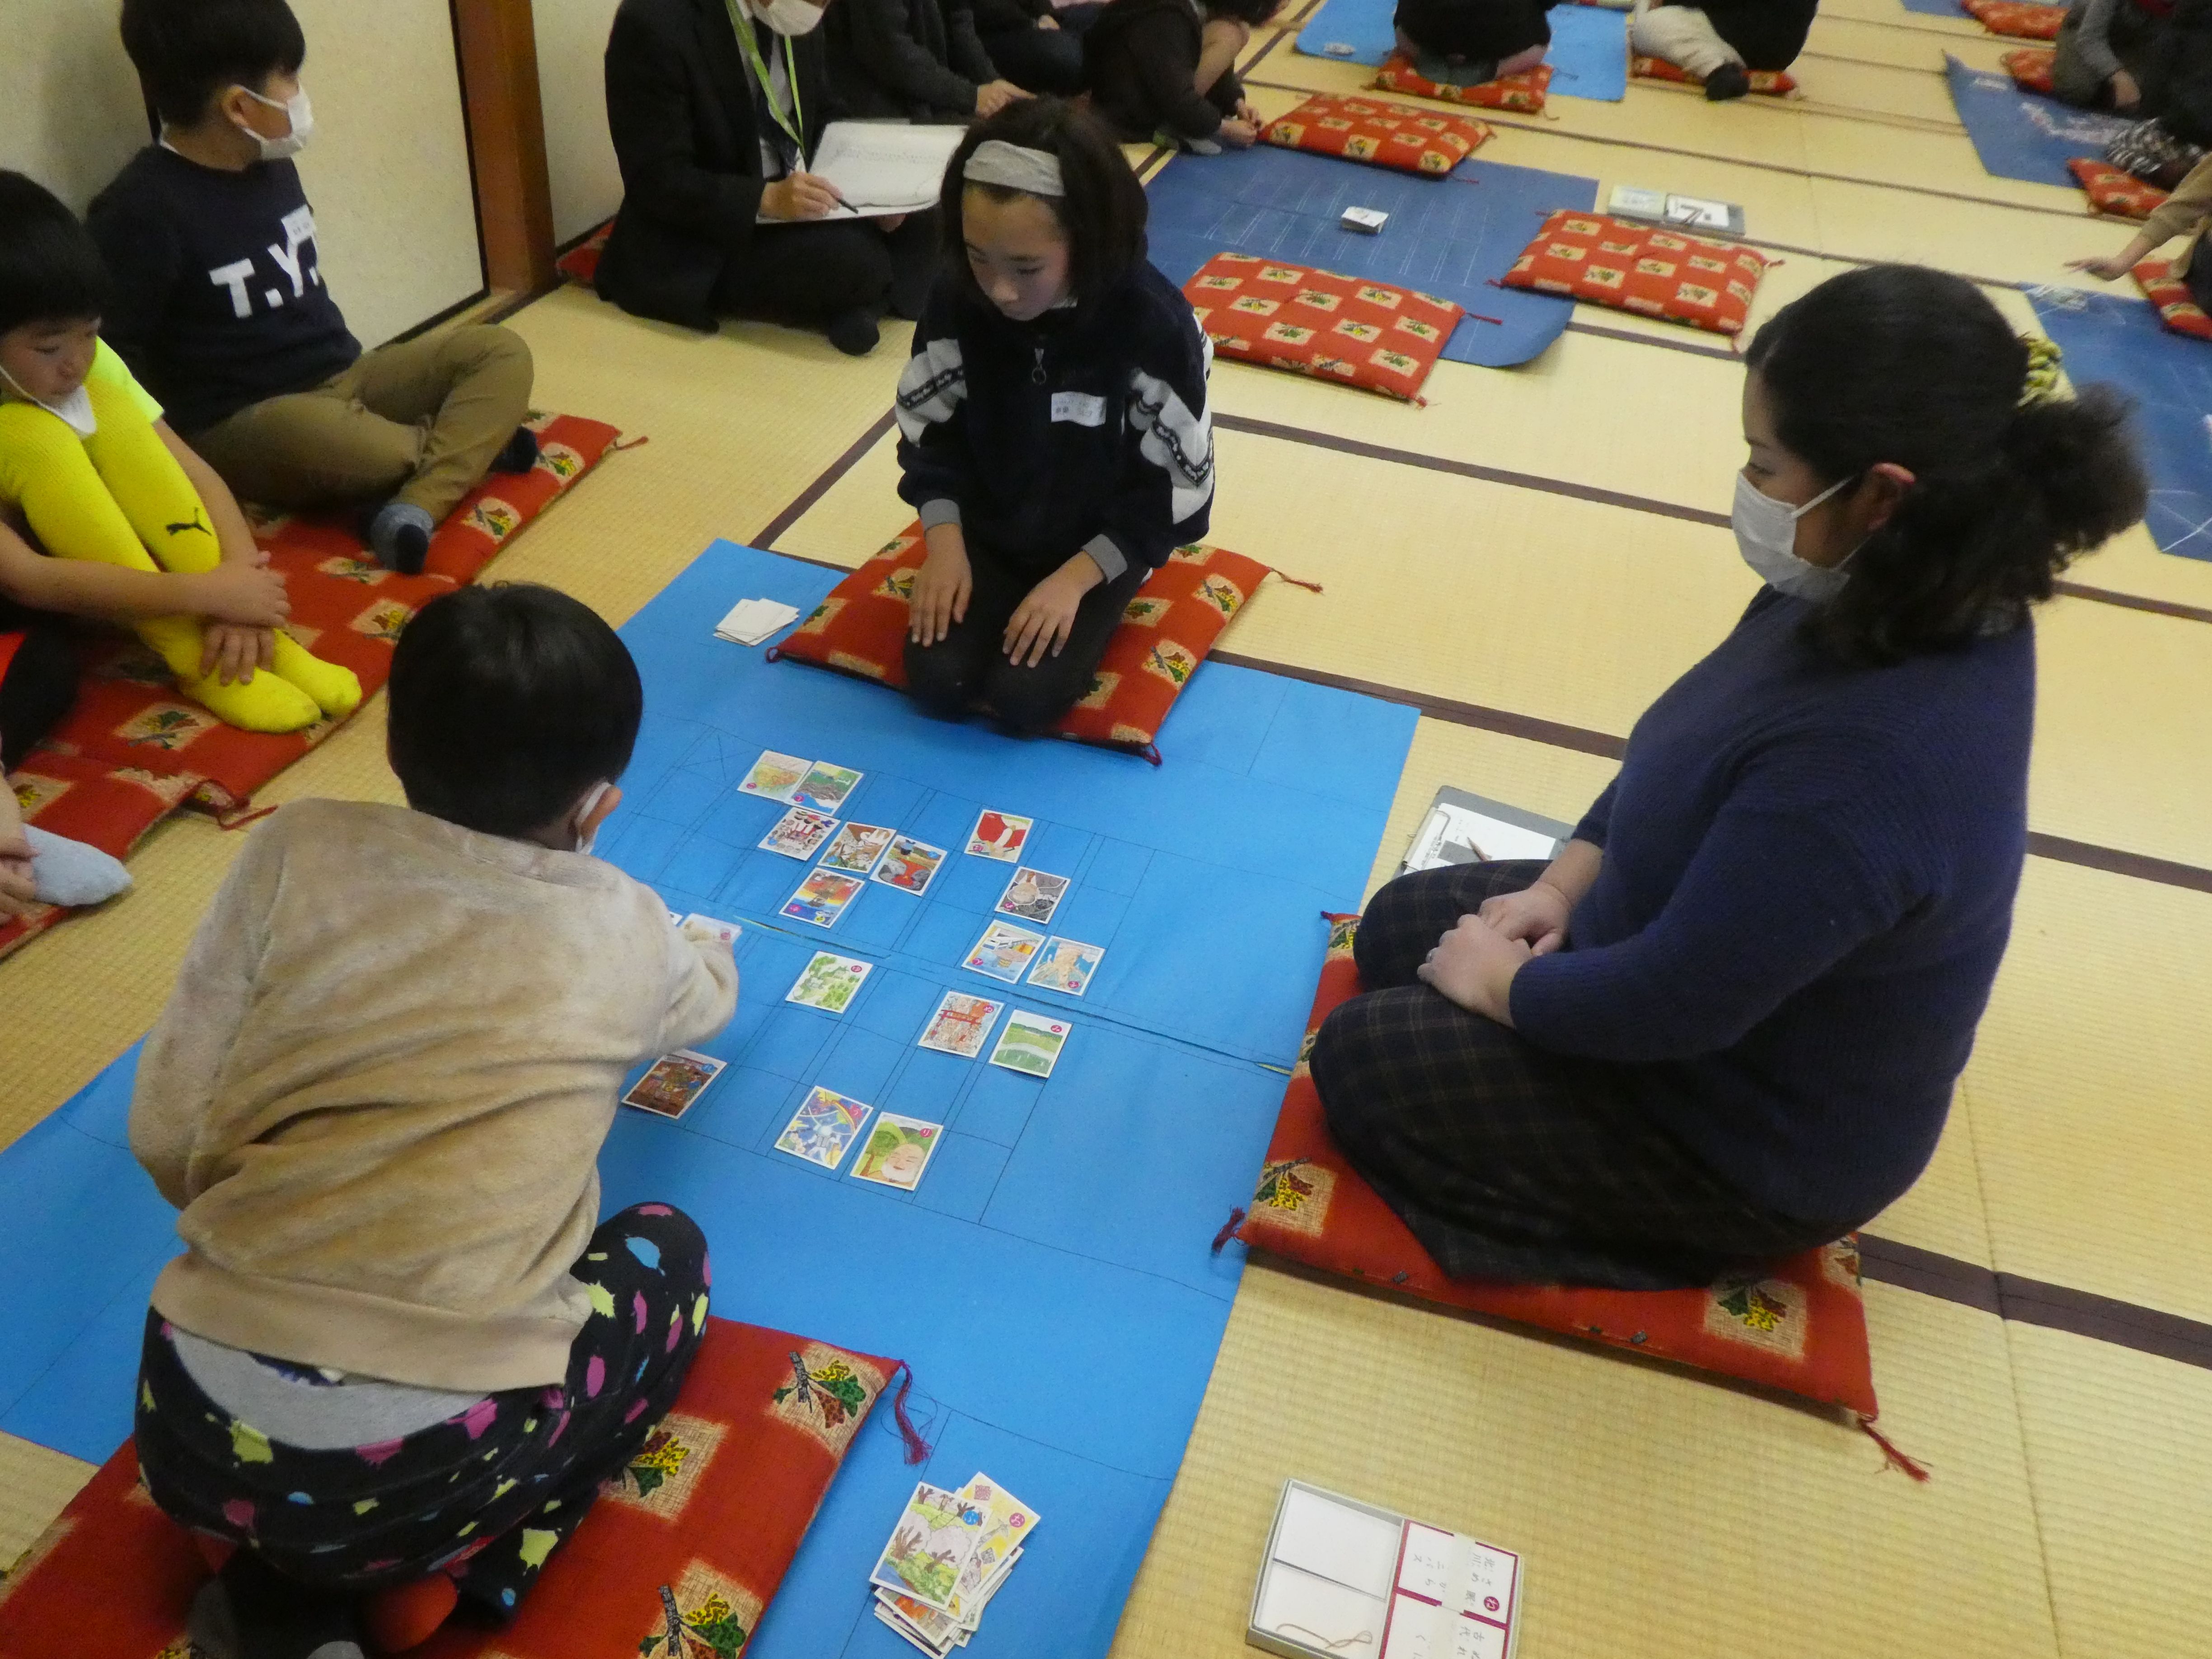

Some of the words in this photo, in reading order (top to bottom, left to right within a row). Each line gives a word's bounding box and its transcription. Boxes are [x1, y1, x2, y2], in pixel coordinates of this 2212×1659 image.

[853, 1108, 860, 1116] う
[922, 1128, 931, 1137] り
[1011, 1514, 1024, 1526] お
[1486, 1597, 1498, 1610] ね
